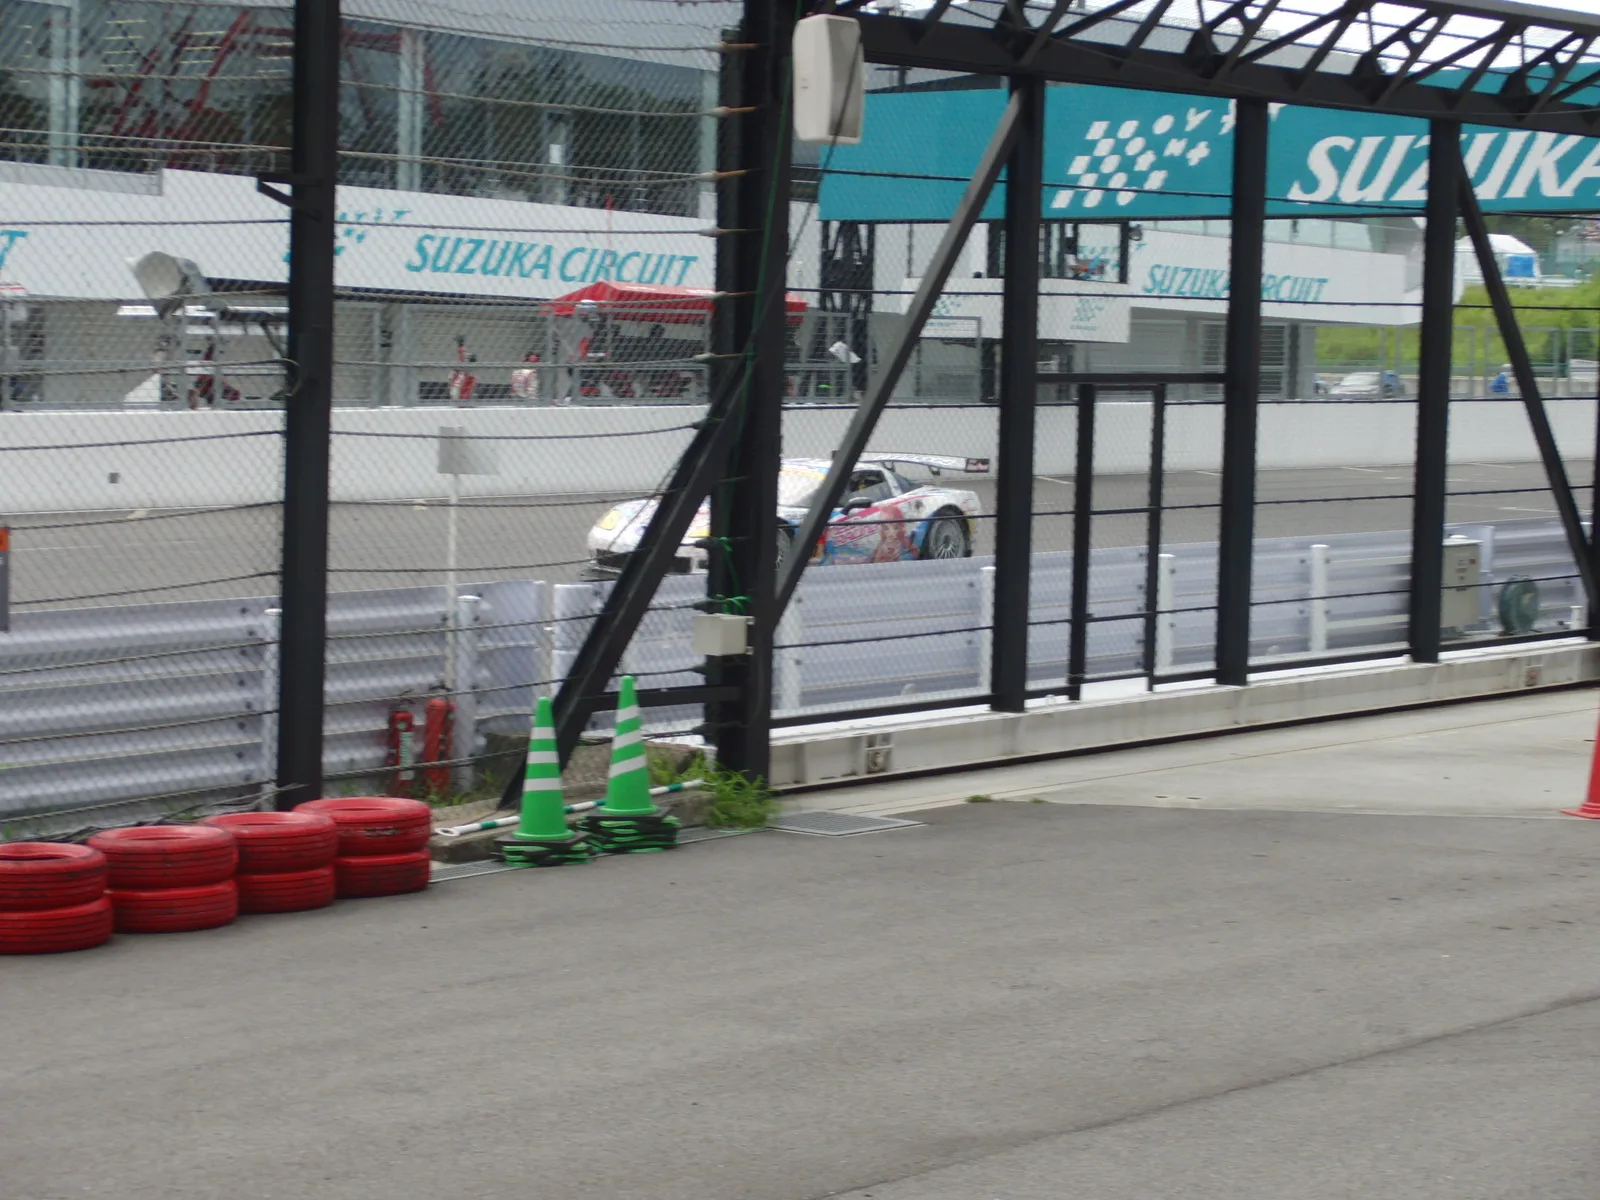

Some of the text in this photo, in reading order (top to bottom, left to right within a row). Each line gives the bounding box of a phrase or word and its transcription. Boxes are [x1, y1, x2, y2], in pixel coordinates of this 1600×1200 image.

[406, 234, 698, 286] SUZUKA CIRCUIT
[1261, 273, 1328, 302] RCUIT
